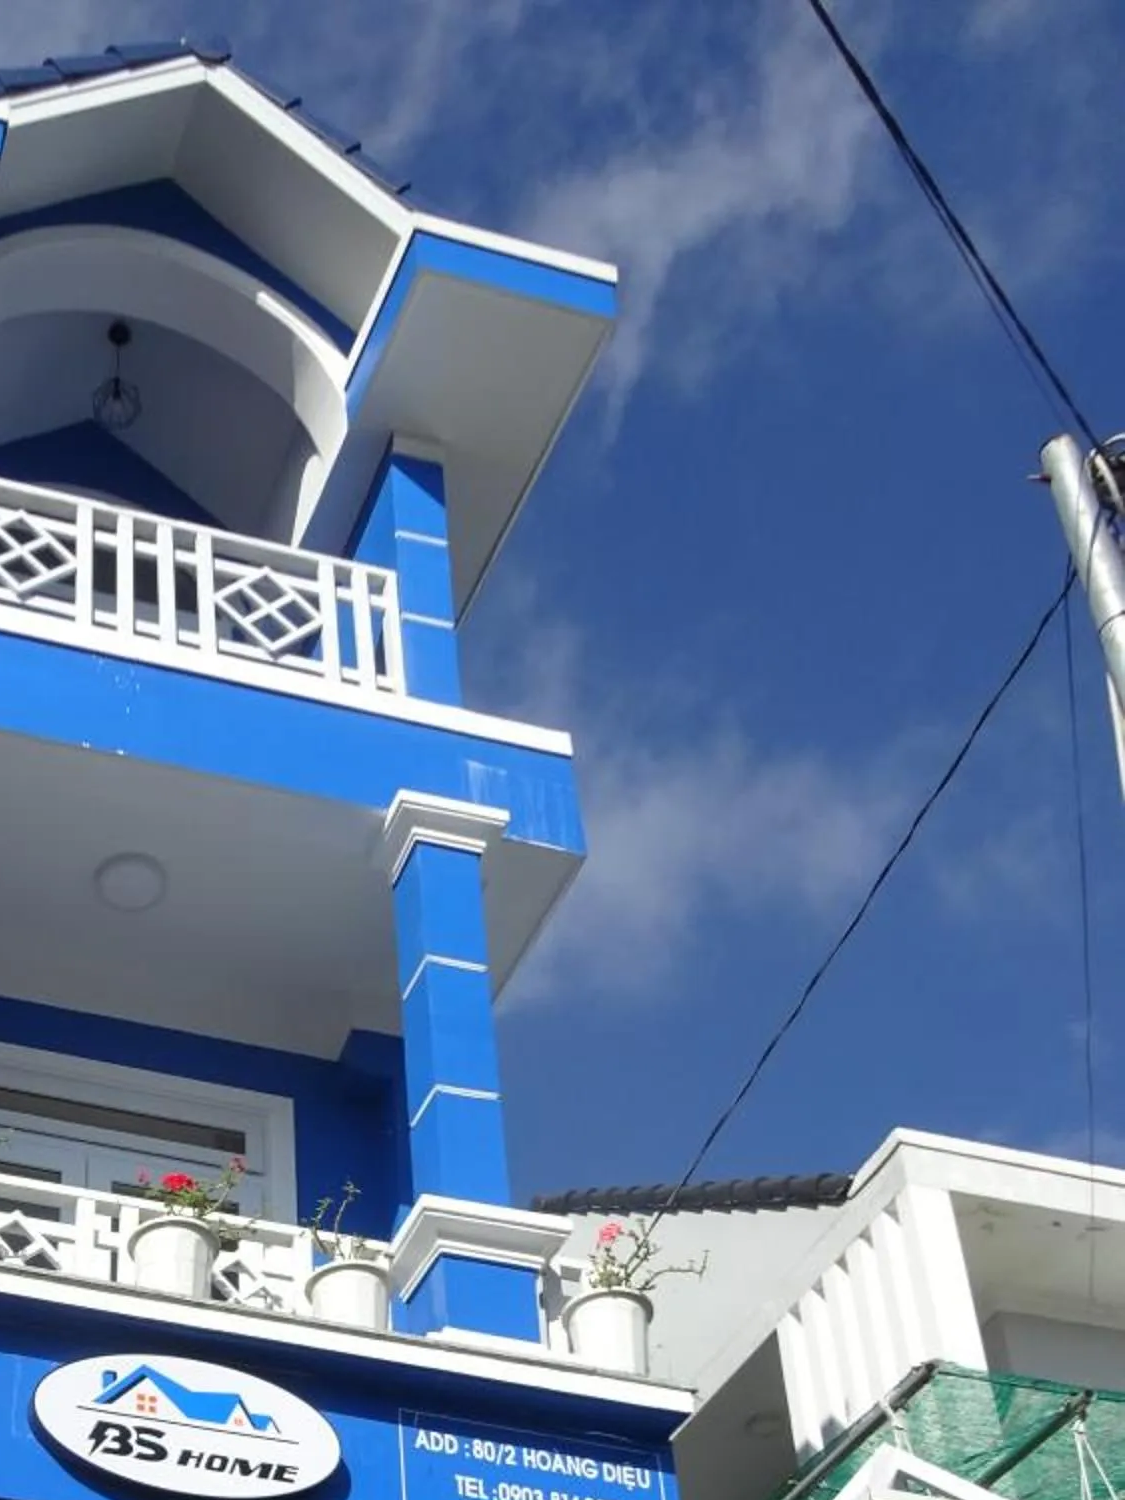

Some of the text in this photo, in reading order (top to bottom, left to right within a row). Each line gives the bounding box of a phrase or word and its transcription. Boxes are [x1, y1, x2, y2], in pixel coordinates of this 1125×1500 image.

[88, 1420, 300, 1484] BS HOME
[415, 1429, 459, 1454] ADD
